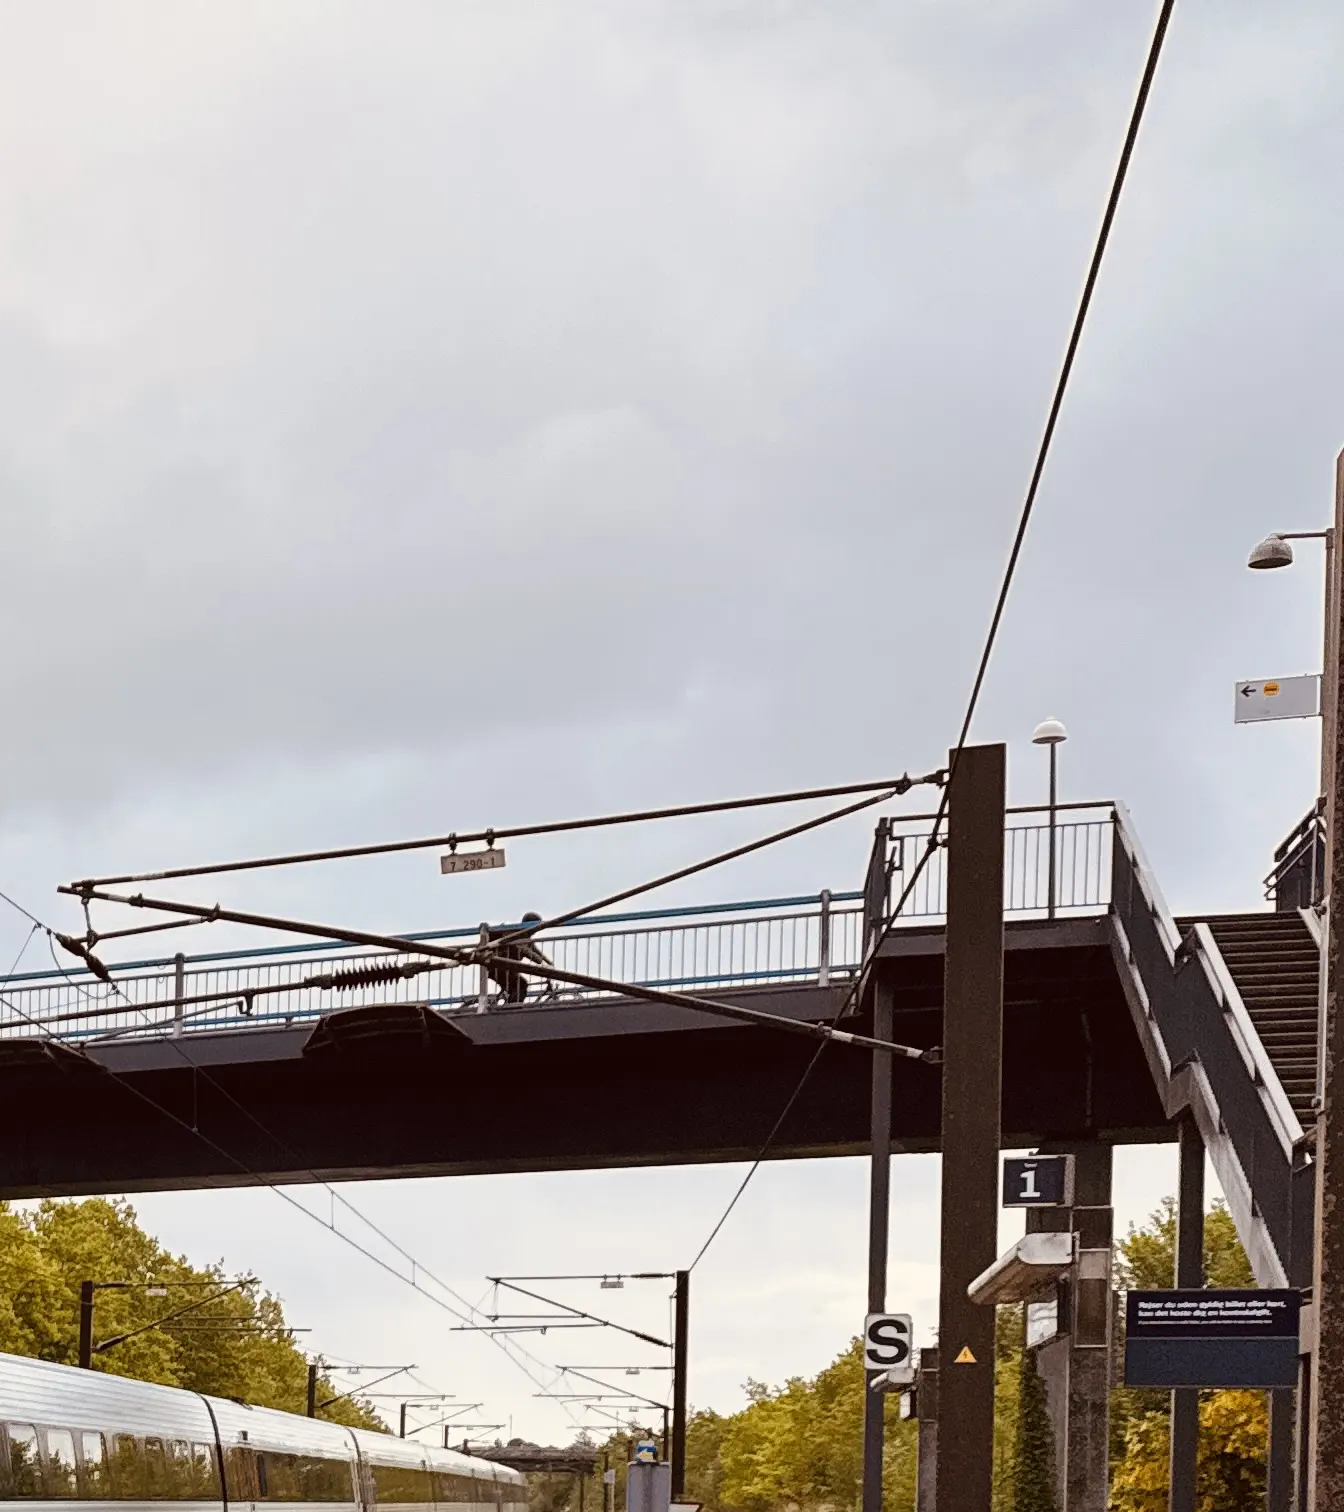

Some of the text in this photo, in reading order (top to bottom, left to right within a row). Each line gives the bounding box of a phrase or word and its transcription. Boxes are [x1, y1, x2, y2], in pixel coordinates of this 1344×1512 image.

[450, 857, 496, 873] 7 290-1
[1020, 1170, 1041, 1197] 1
[867, 1319, 909, 1364] S
